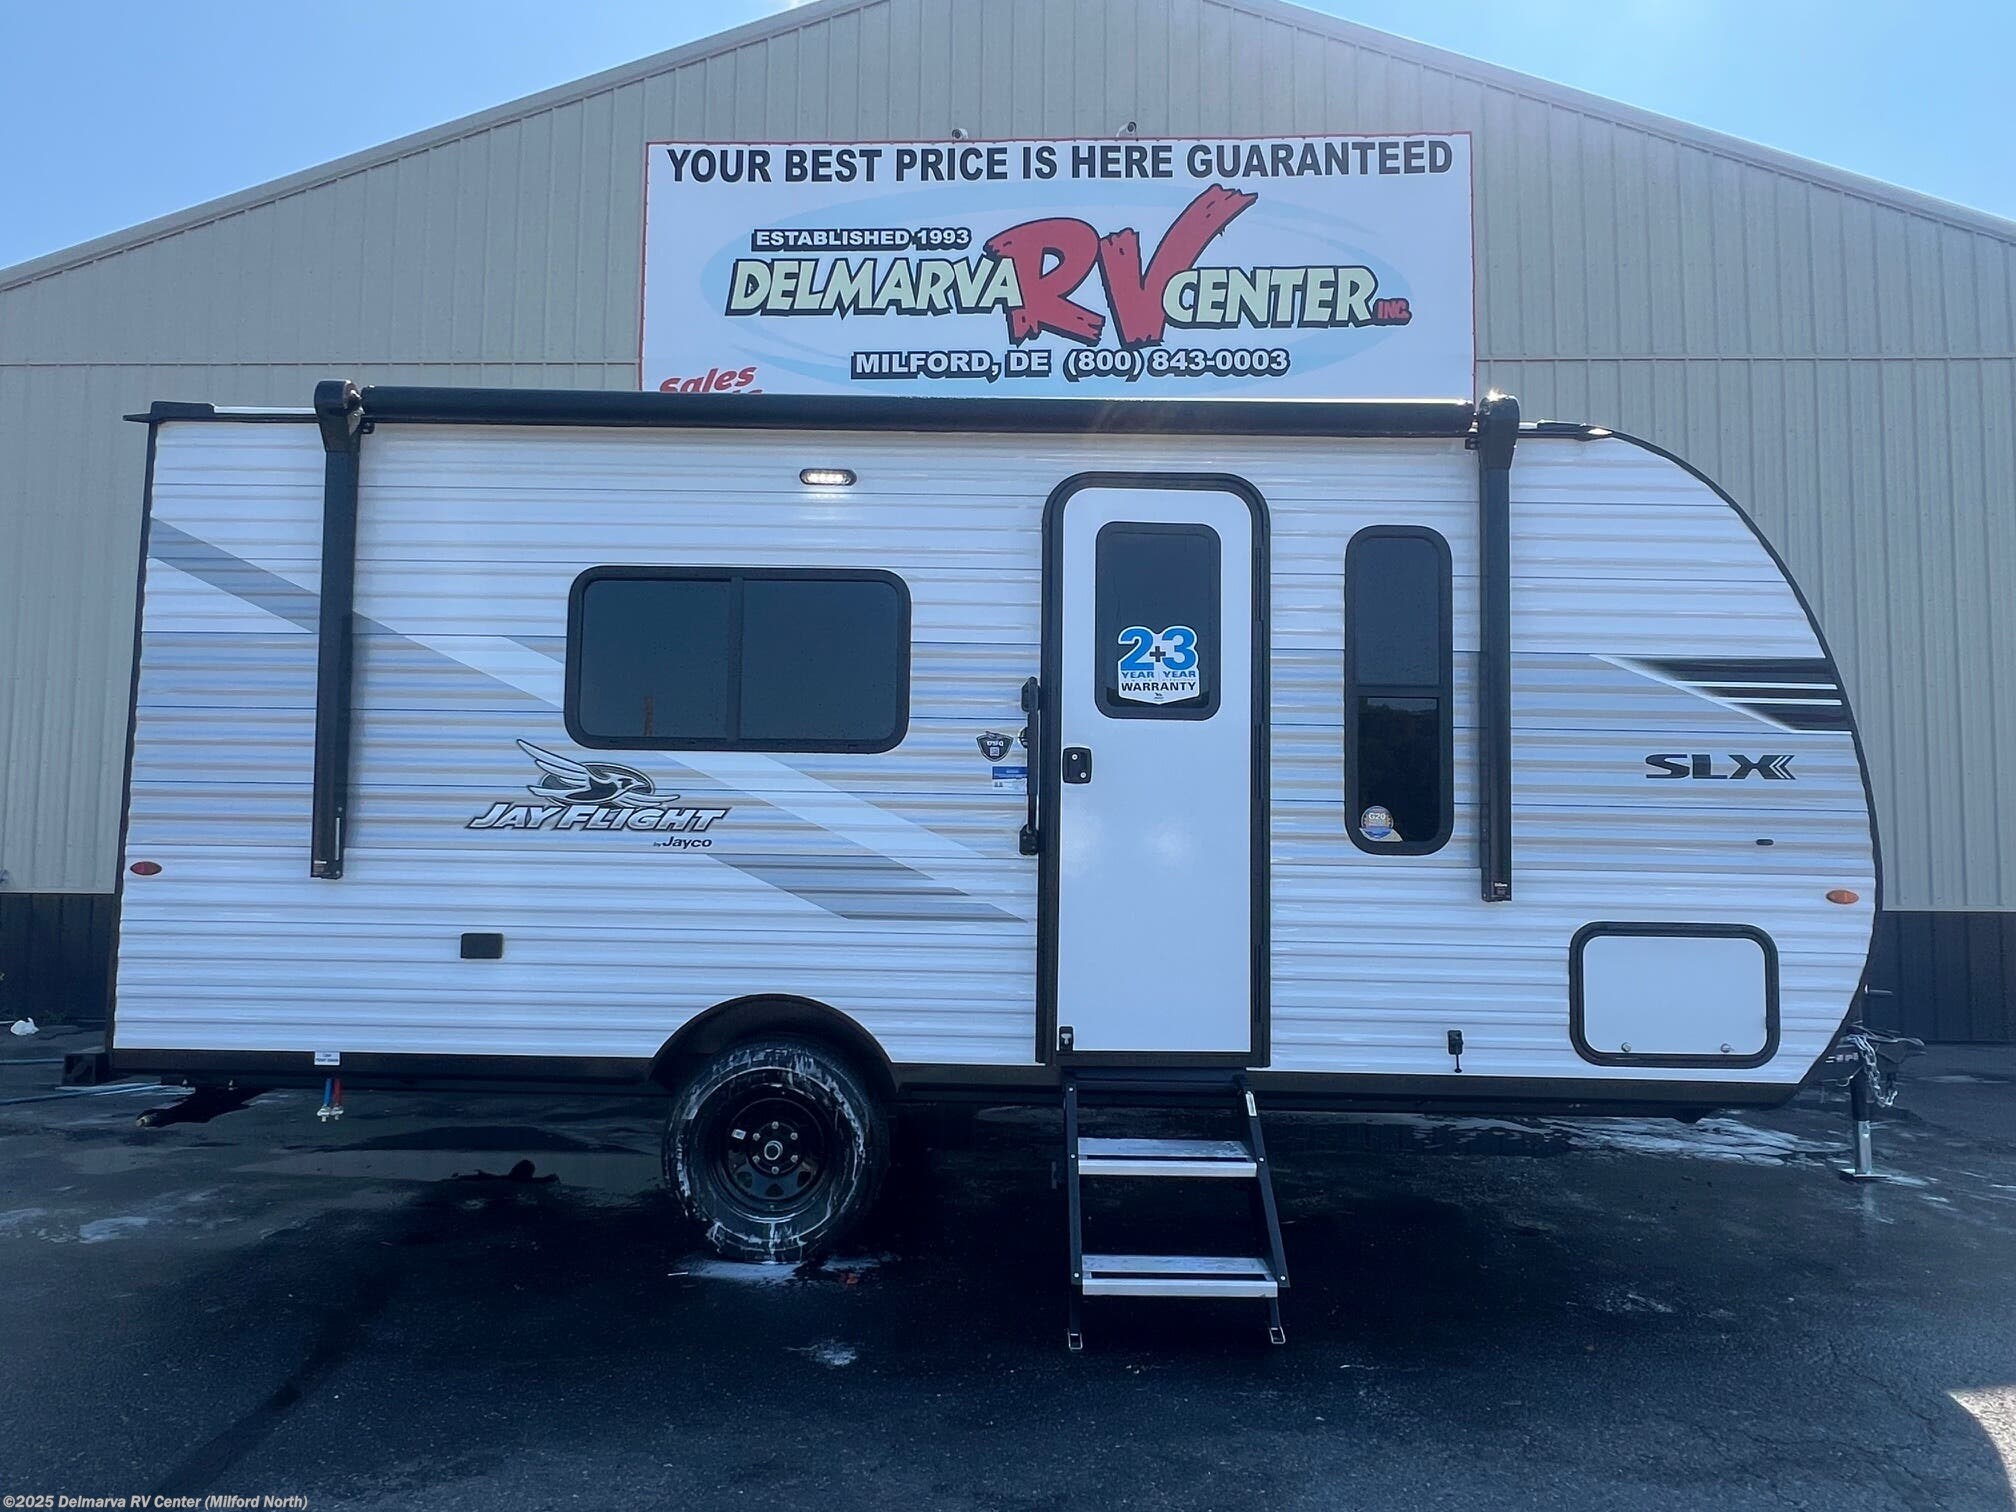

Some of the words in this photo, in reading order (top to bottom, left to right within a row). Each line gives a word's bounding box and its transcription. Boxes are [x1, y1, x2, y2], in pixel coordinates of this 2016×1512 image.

[666, 148, 773, 183] YOUR
[784, 148, 883, 183] BEST
[896, 146, 1008, 182] PRICE
[1022, 145, 1058, 180] IS
[1071, 144, 1174, 179] HERE
[1186, 140, 1453, 178] GUARANTEED
[754, 229, 910, 248] ESTABLISHED
[916, 229, 971, 246] 1993
[727, 255, 1025, 315] DELMARVA
[983, 183, 1258, 348] RV
[1163, 266, 1377, 326] CENTER
[853, 351, 1001, 381] MILFORD,
[1007, 350, 1050, 377] DE
[1064, 350, 1144, 380] (800)
[1150, 349, 1290, 376] 843-0003
[1121, 671, 1155, 679] YEAR
[1162, 670, 1197, 678] YEAR
[1121, 682, 1197, 692] WARRANTY
[1645, 753, 1796, 781] SLX
[466, 802, 560, 830] JAY
[551, 805, 731, 832] FLIGHT
[1368, 812, 1386, 820] G20
[660, 836, 713, 849] Jayco
